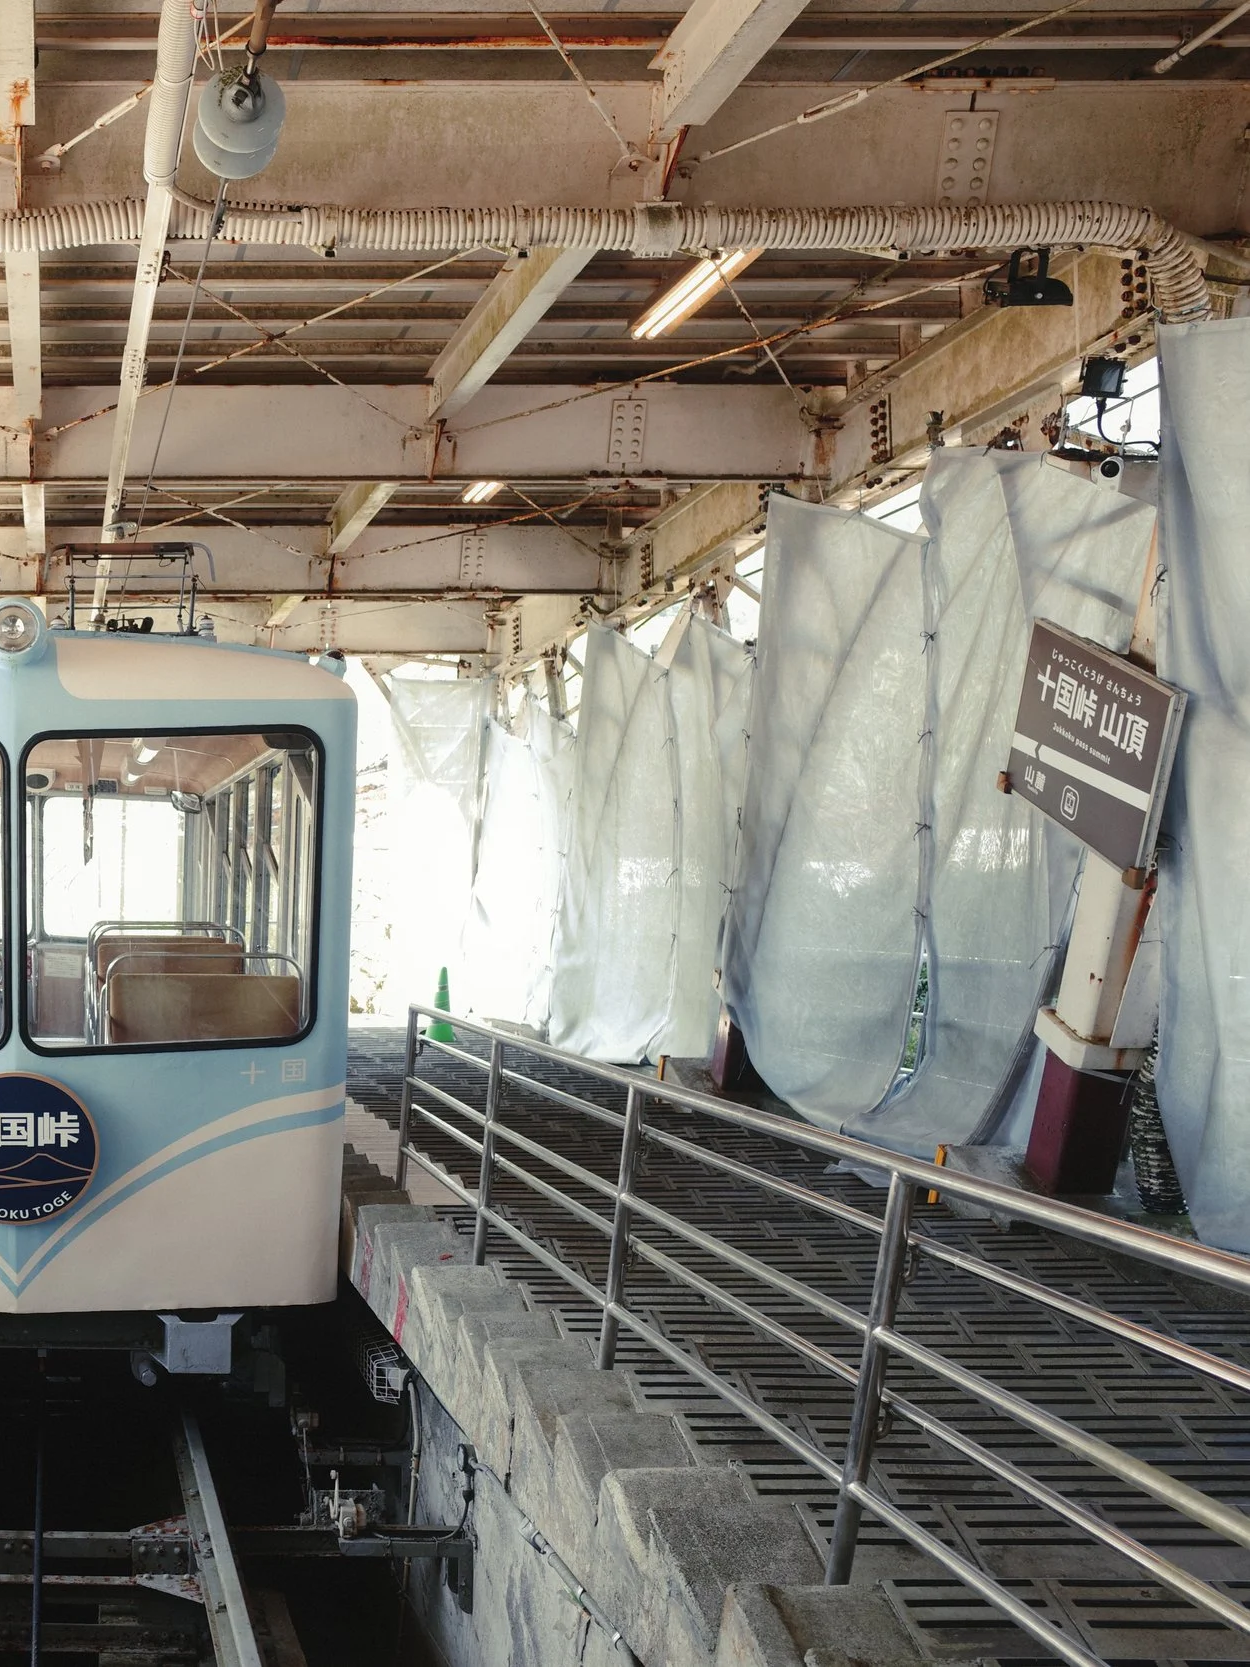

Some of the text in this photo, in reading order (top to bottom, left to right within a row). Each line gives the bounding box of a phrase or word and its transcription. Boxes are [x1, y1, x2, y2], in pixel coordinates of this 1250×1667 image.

[1052, 648, 1142, 706] じゅっこくとうげ さんちょう
[1037, 664, 1149, 761] 十国峠 山頂
[1052, 722, 1111, 765] Jukkoku pass summit
[32, 1190, 73, 1217] TOGE
